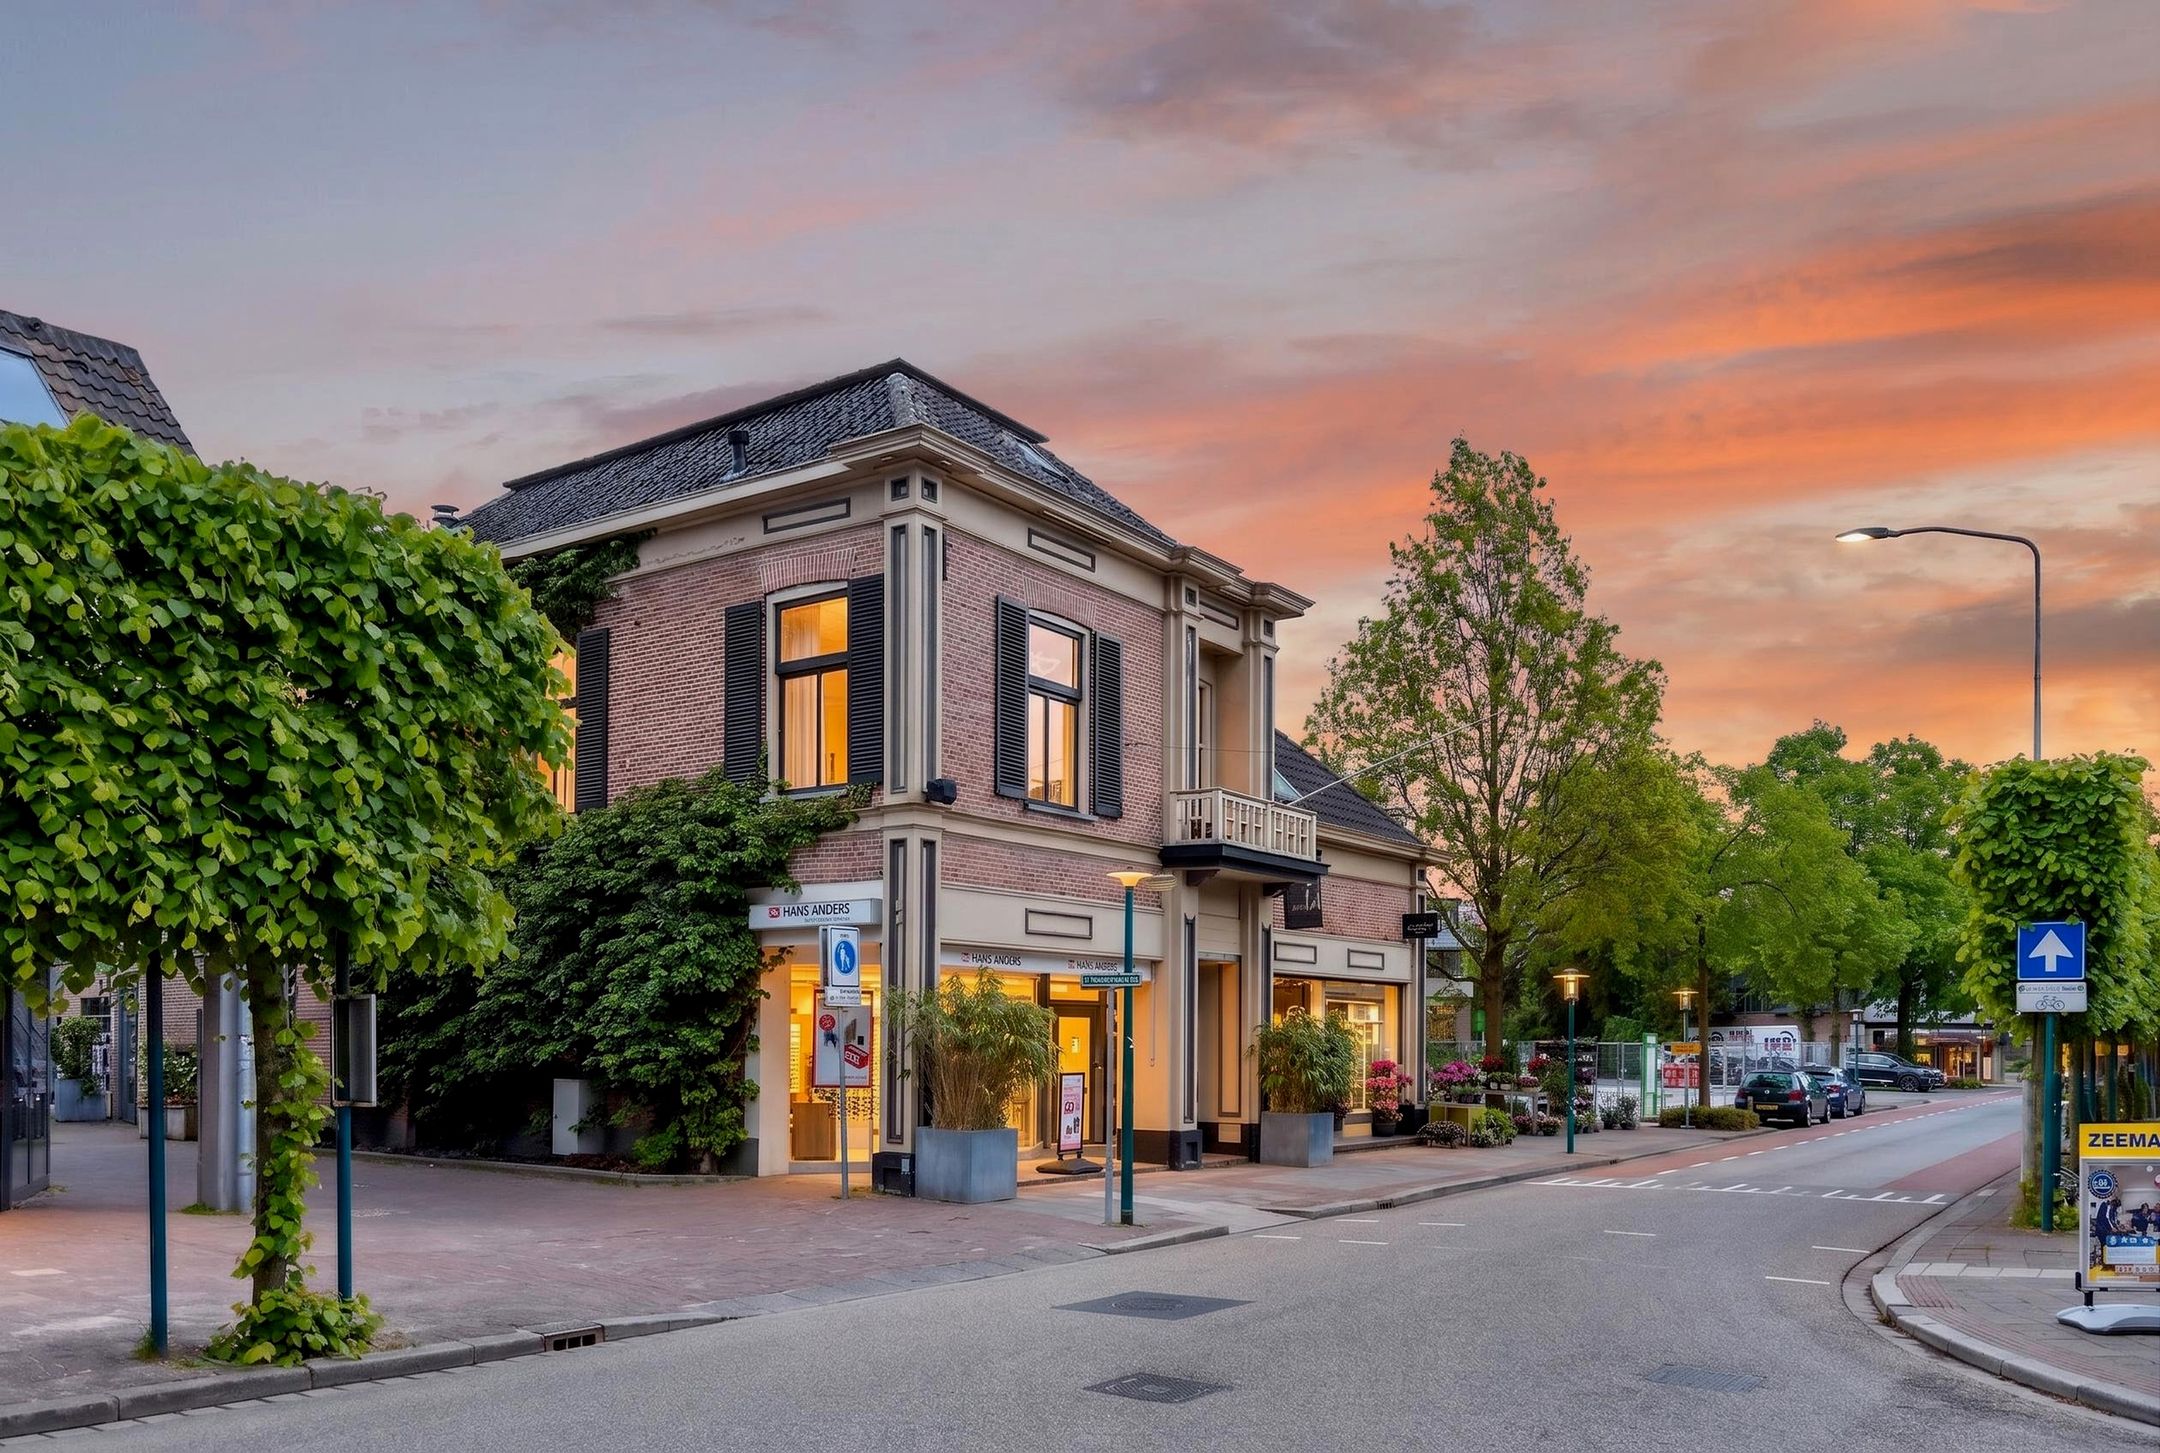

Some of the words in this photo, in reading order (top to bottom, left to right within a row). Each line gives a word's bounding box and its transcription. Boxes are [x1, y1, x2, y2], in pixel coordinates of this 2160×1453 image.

[783, 905, 809, 917] HANS
[811, 903, 850, 916] ANDERS
[972, 953, 992, 965] HANS
[1076, 960, 1094, 970] HANS
[2088, 1133, 2160, 1148] ZEEMA
